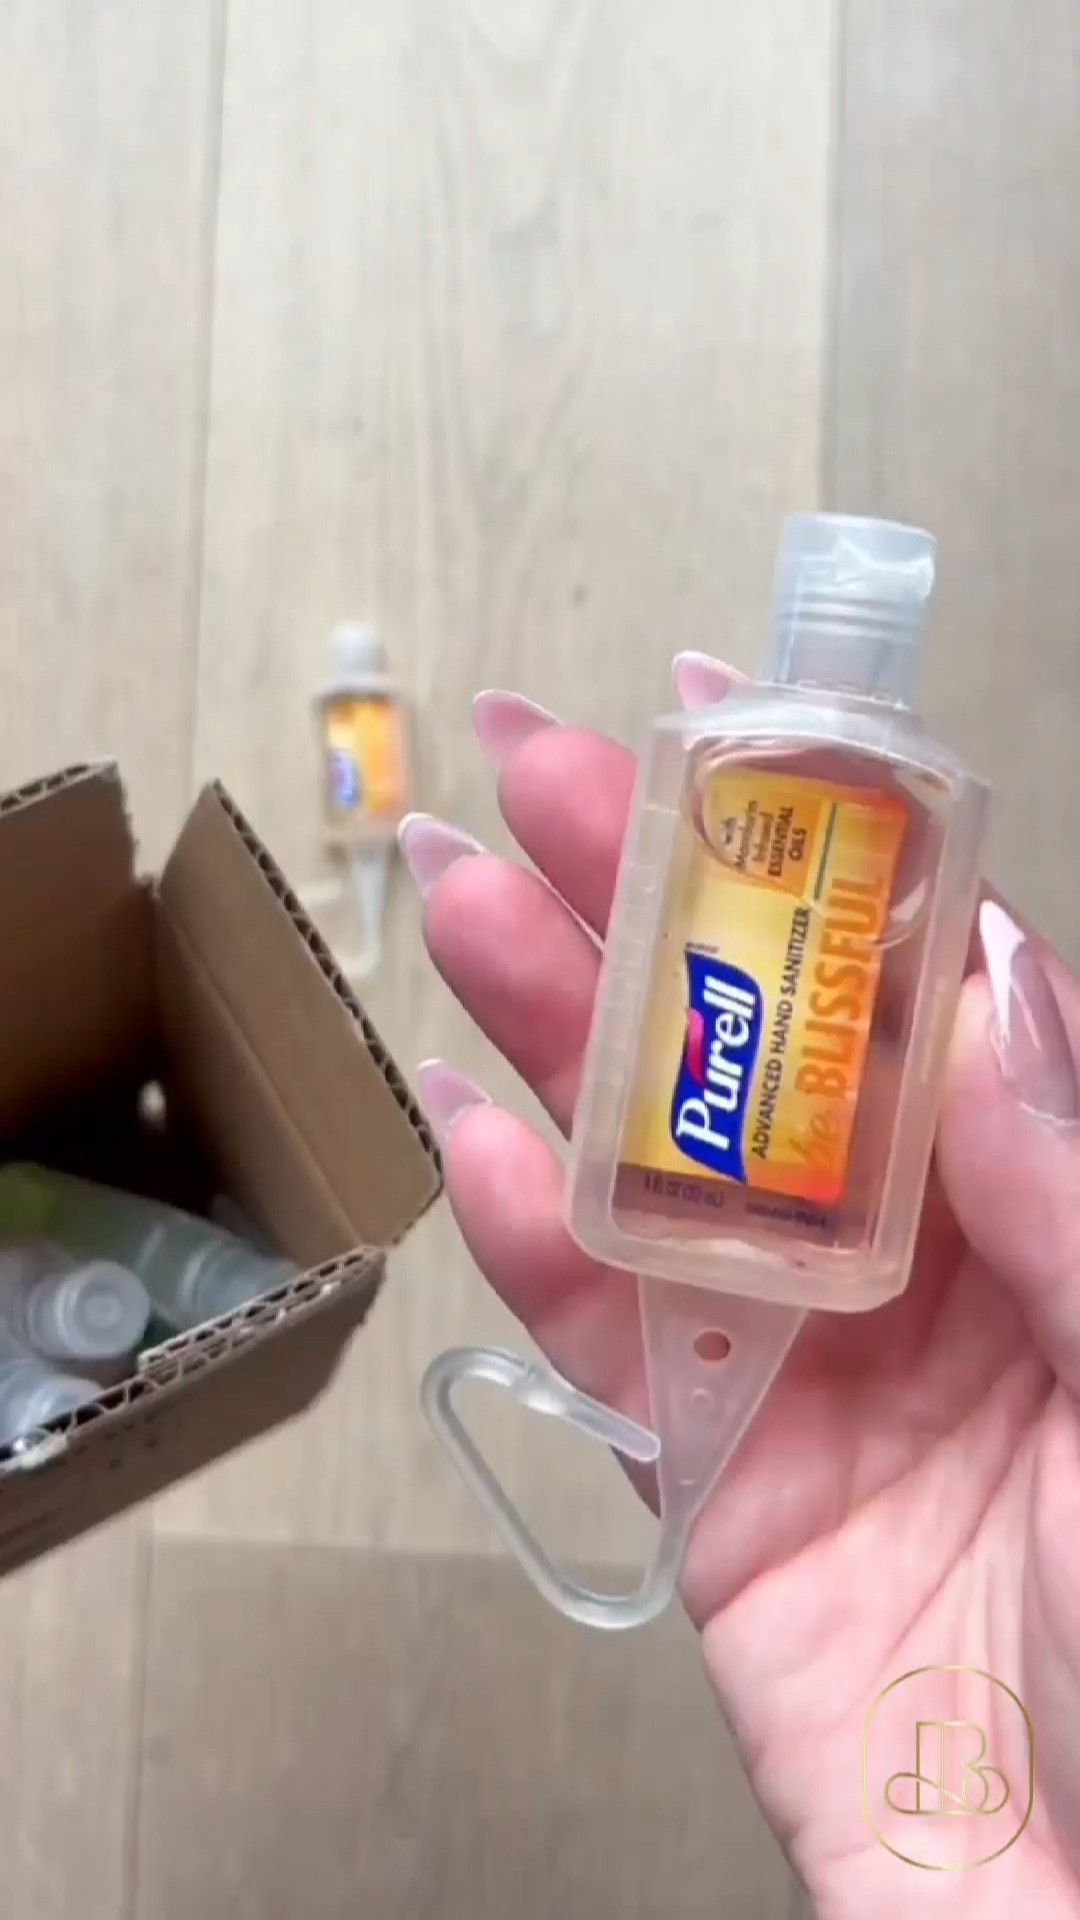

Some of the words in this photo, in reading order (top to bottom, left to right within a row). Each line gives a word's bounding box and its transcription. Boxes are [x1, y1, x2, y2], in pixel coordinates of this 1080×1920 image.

[768, 807, 793, 877] ESSENTIAL
[788, 828, 806, 861] OILS
[780, 906, 812, 998] SANITIZER
[794, 875, 885, 1099] BLISSFUL
[676, 975, 756, 1151] Purell
[773, 999, 793, 1057] HAND
[752, 1058, 782, 1160] ADVANCED
